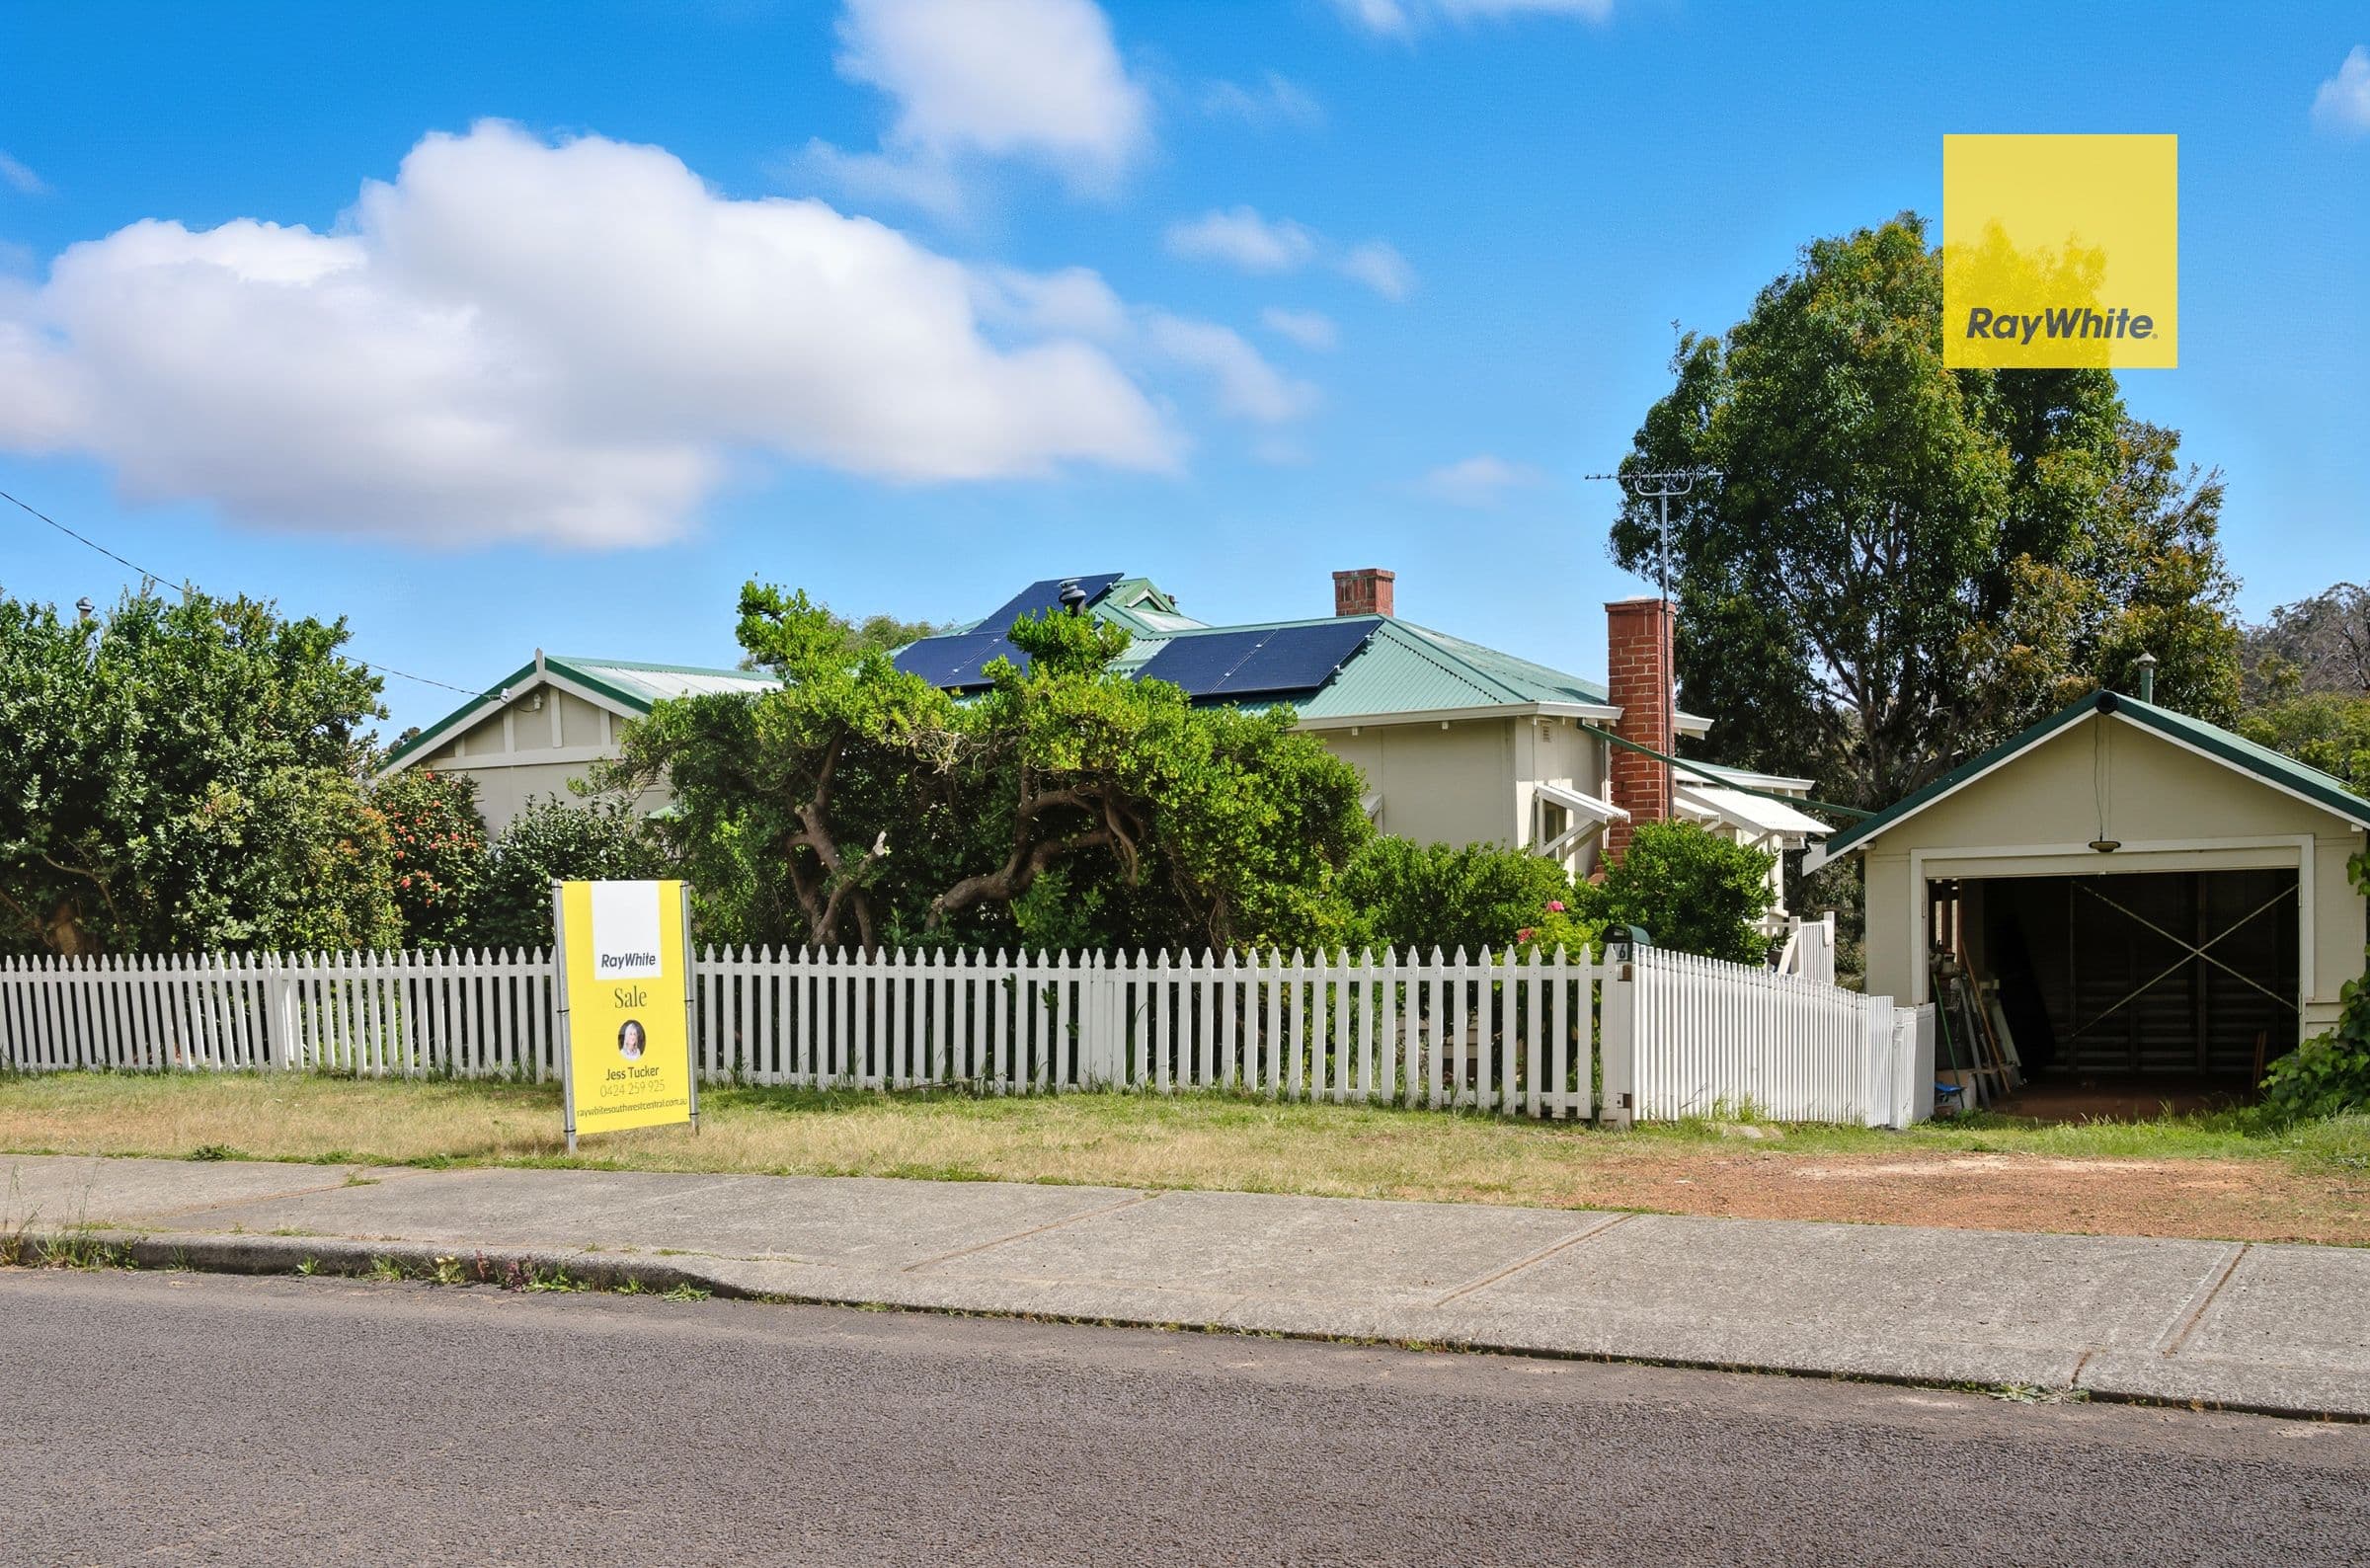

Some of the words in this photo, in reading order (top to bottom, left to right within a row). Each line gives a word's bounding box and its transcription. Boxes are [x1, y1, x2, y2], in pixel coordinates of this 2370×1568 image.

[601, 952, 656, 970] RayWhite
[614, 984, 647, 1008] Sale
[606, 1068, 626, 1081] Jess
[628, 1065, 660, 1079] Tucker
[600, 1083, 625, 1097] 0424
[628, 1081, 646, 1095] 259
[648, 1079, 666, 1092] 925
